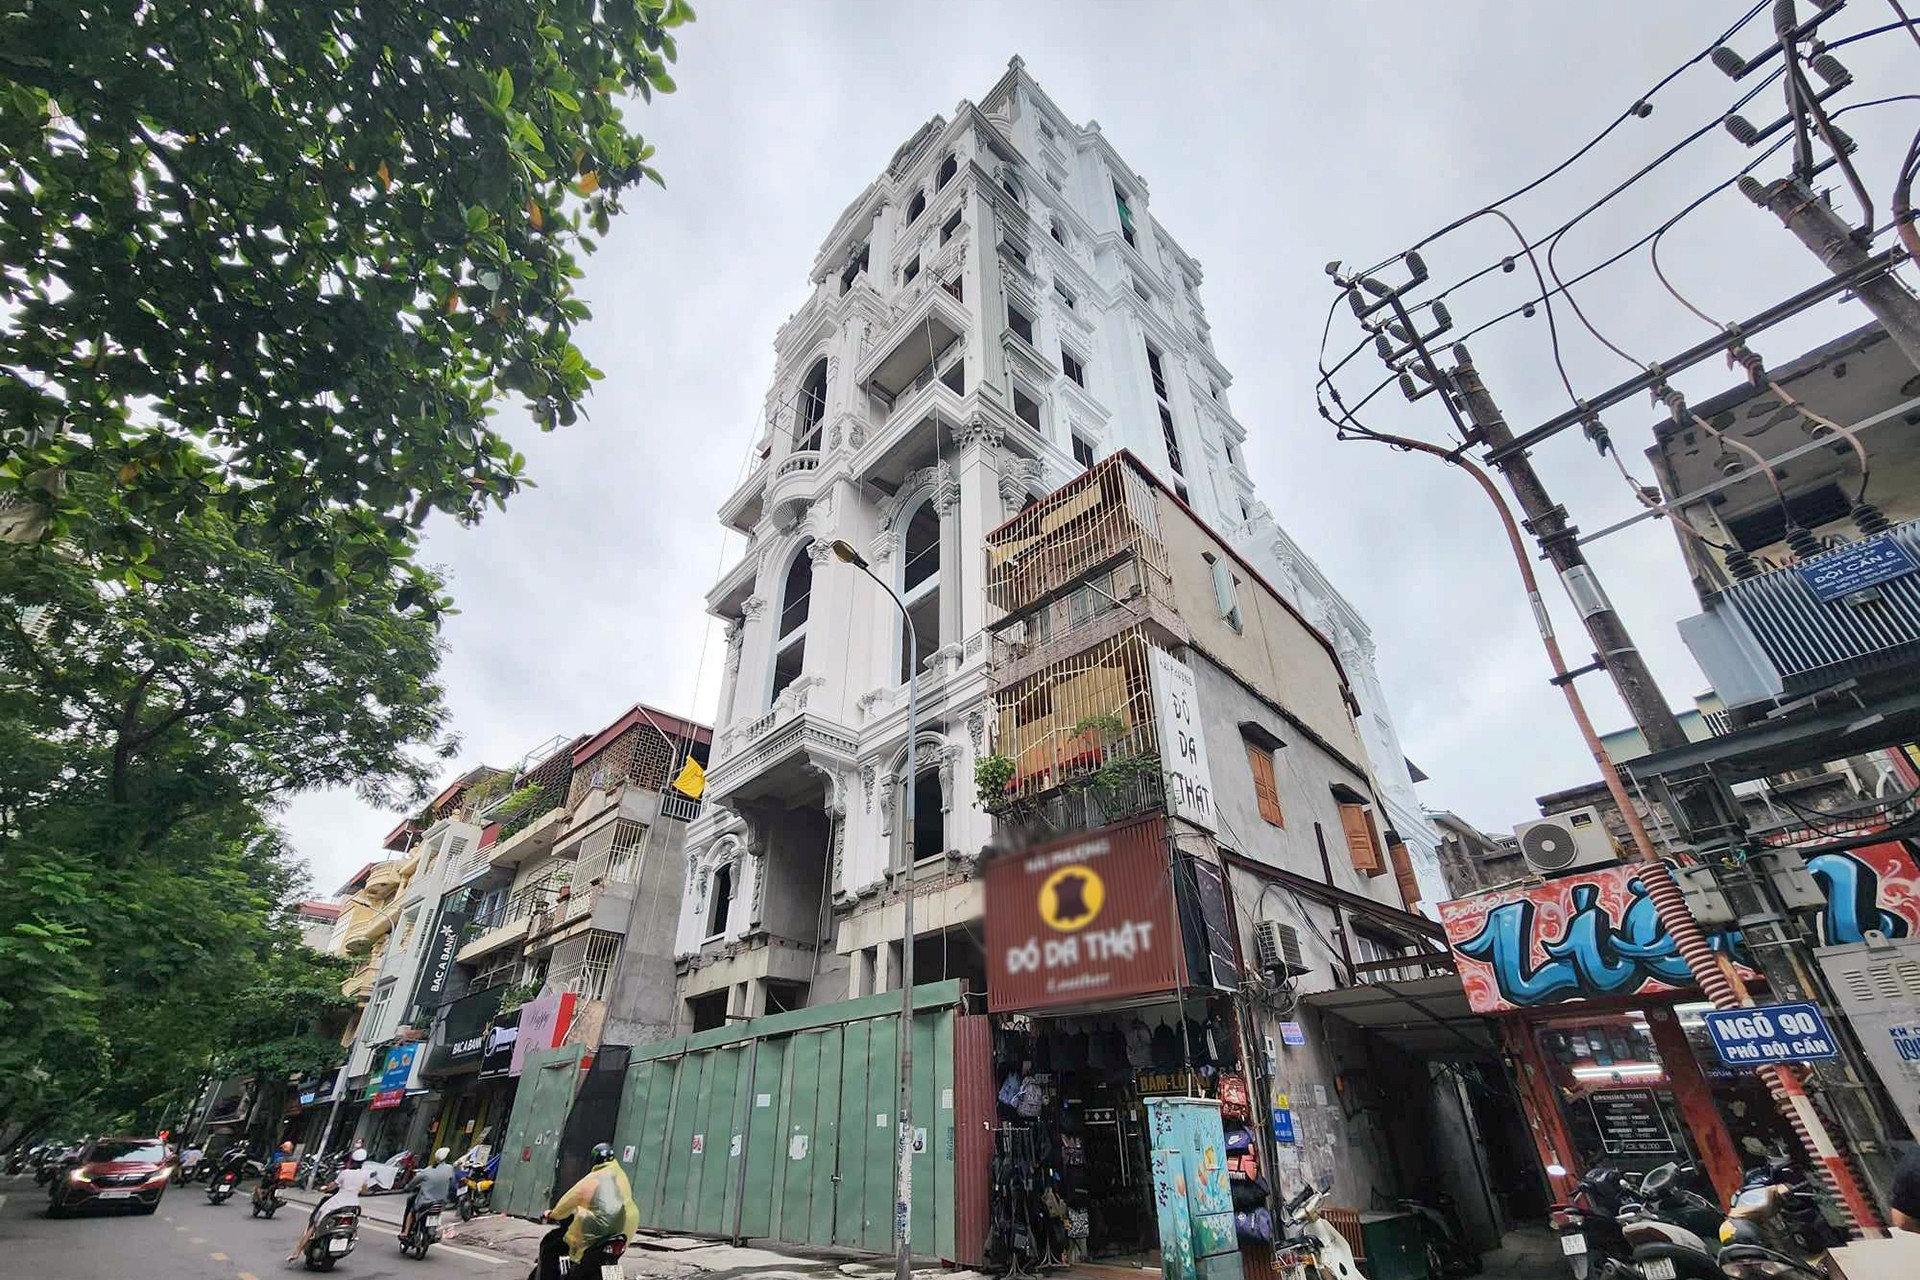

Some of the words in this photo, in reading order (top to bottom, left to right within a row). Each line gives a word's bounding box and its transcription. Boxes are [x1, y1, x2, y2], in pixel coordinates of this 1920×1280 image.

[1178, 730, 1198, 765] DA
[1176, 773, 1211, 821] THẬT
[430, 971, 444, 992] BAC
[440, 933, 456, 960] BANK
[1715, 1012, 1774, 1040] NGÕ
[1778, 1012, 1817, 1035] 90
[1726, 1041, 1760, 1058] PHỐ
[1761, 1041, 1791, 1059] ĐỘI
